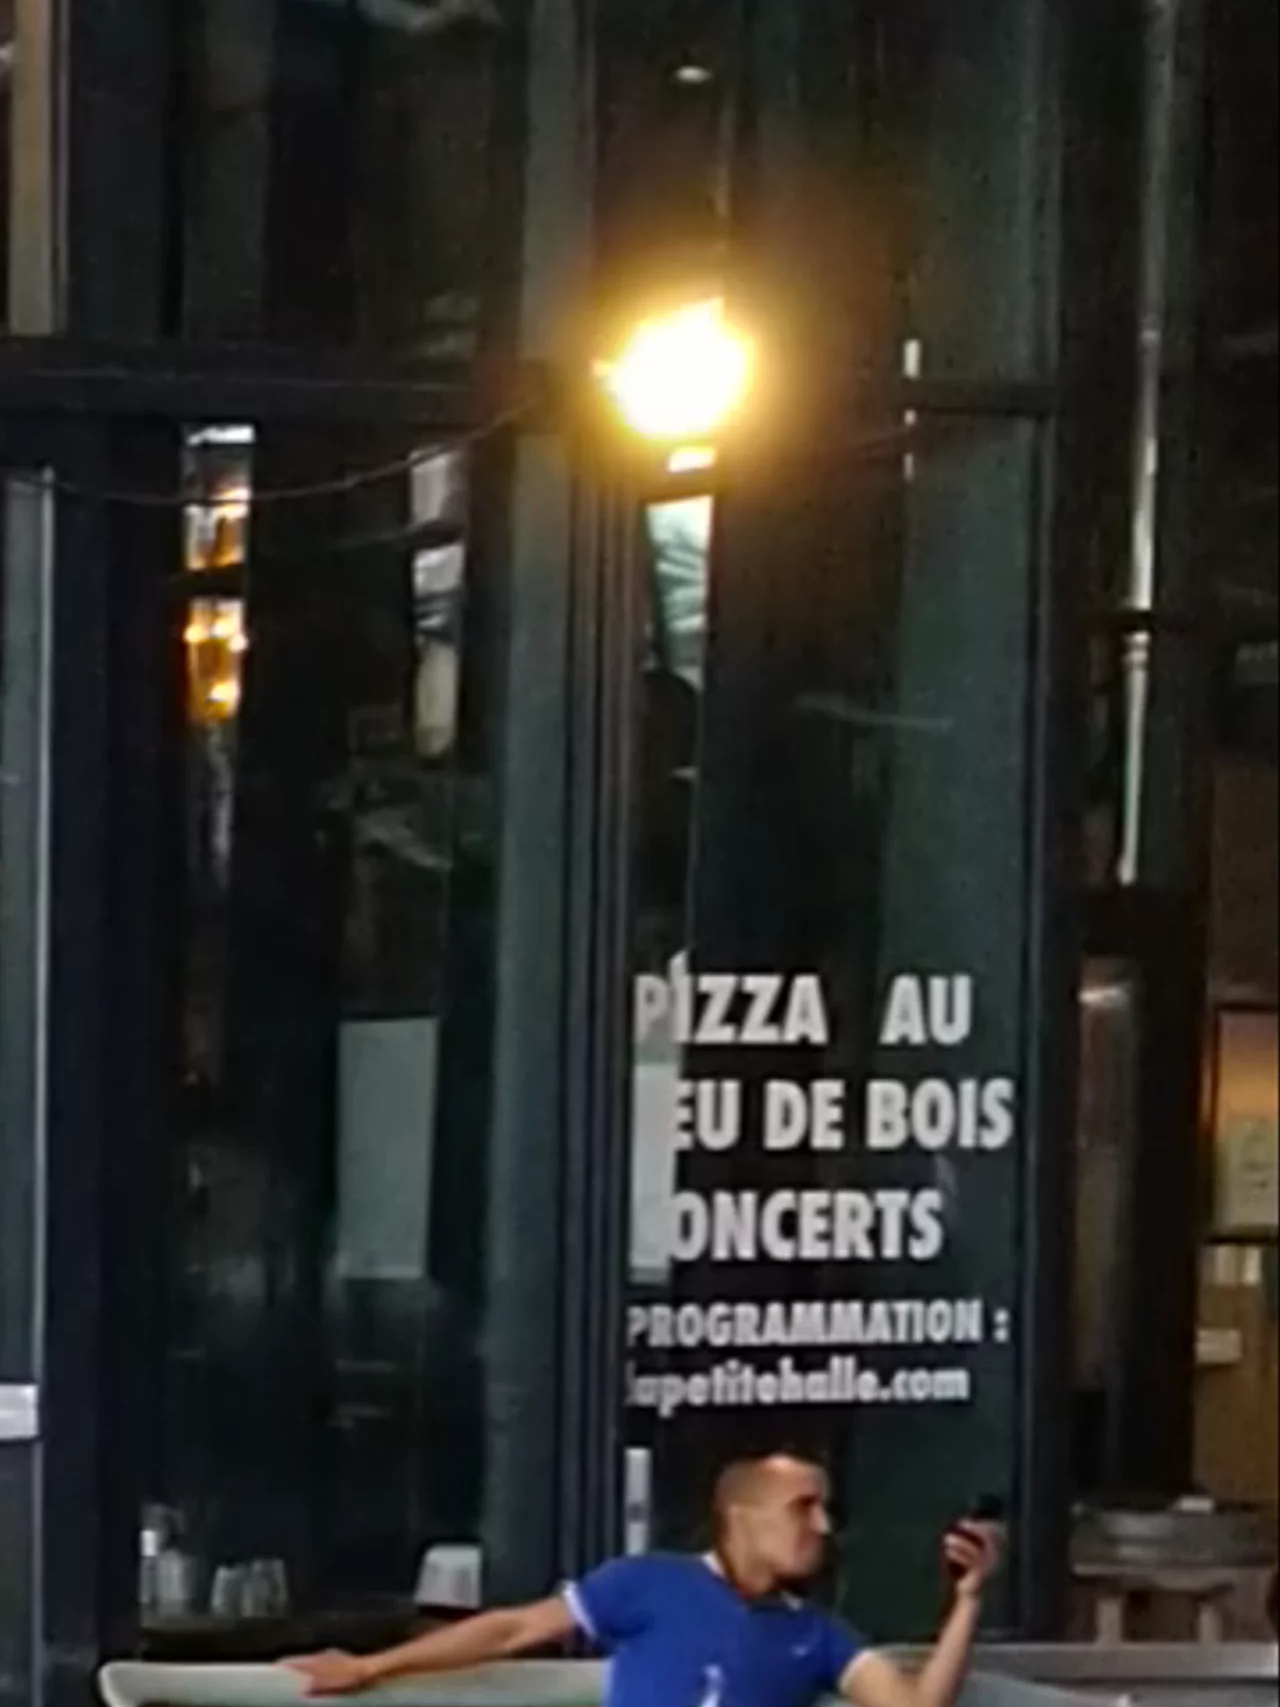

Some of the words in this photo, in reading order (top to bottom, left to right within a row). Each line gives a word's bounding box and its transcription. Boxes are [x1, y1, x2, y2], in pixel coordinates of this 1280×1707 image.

[634, 973, 829, 1045] PIZZA
[879, 973, 973, 1045] AU
[652, 1078, 742, 1150] EU
[763, 1078, 845, 1150] DE
[866, 1077, 1015, 1150] BOIS
[652, 1189, 943, 1261] ONCERTS
